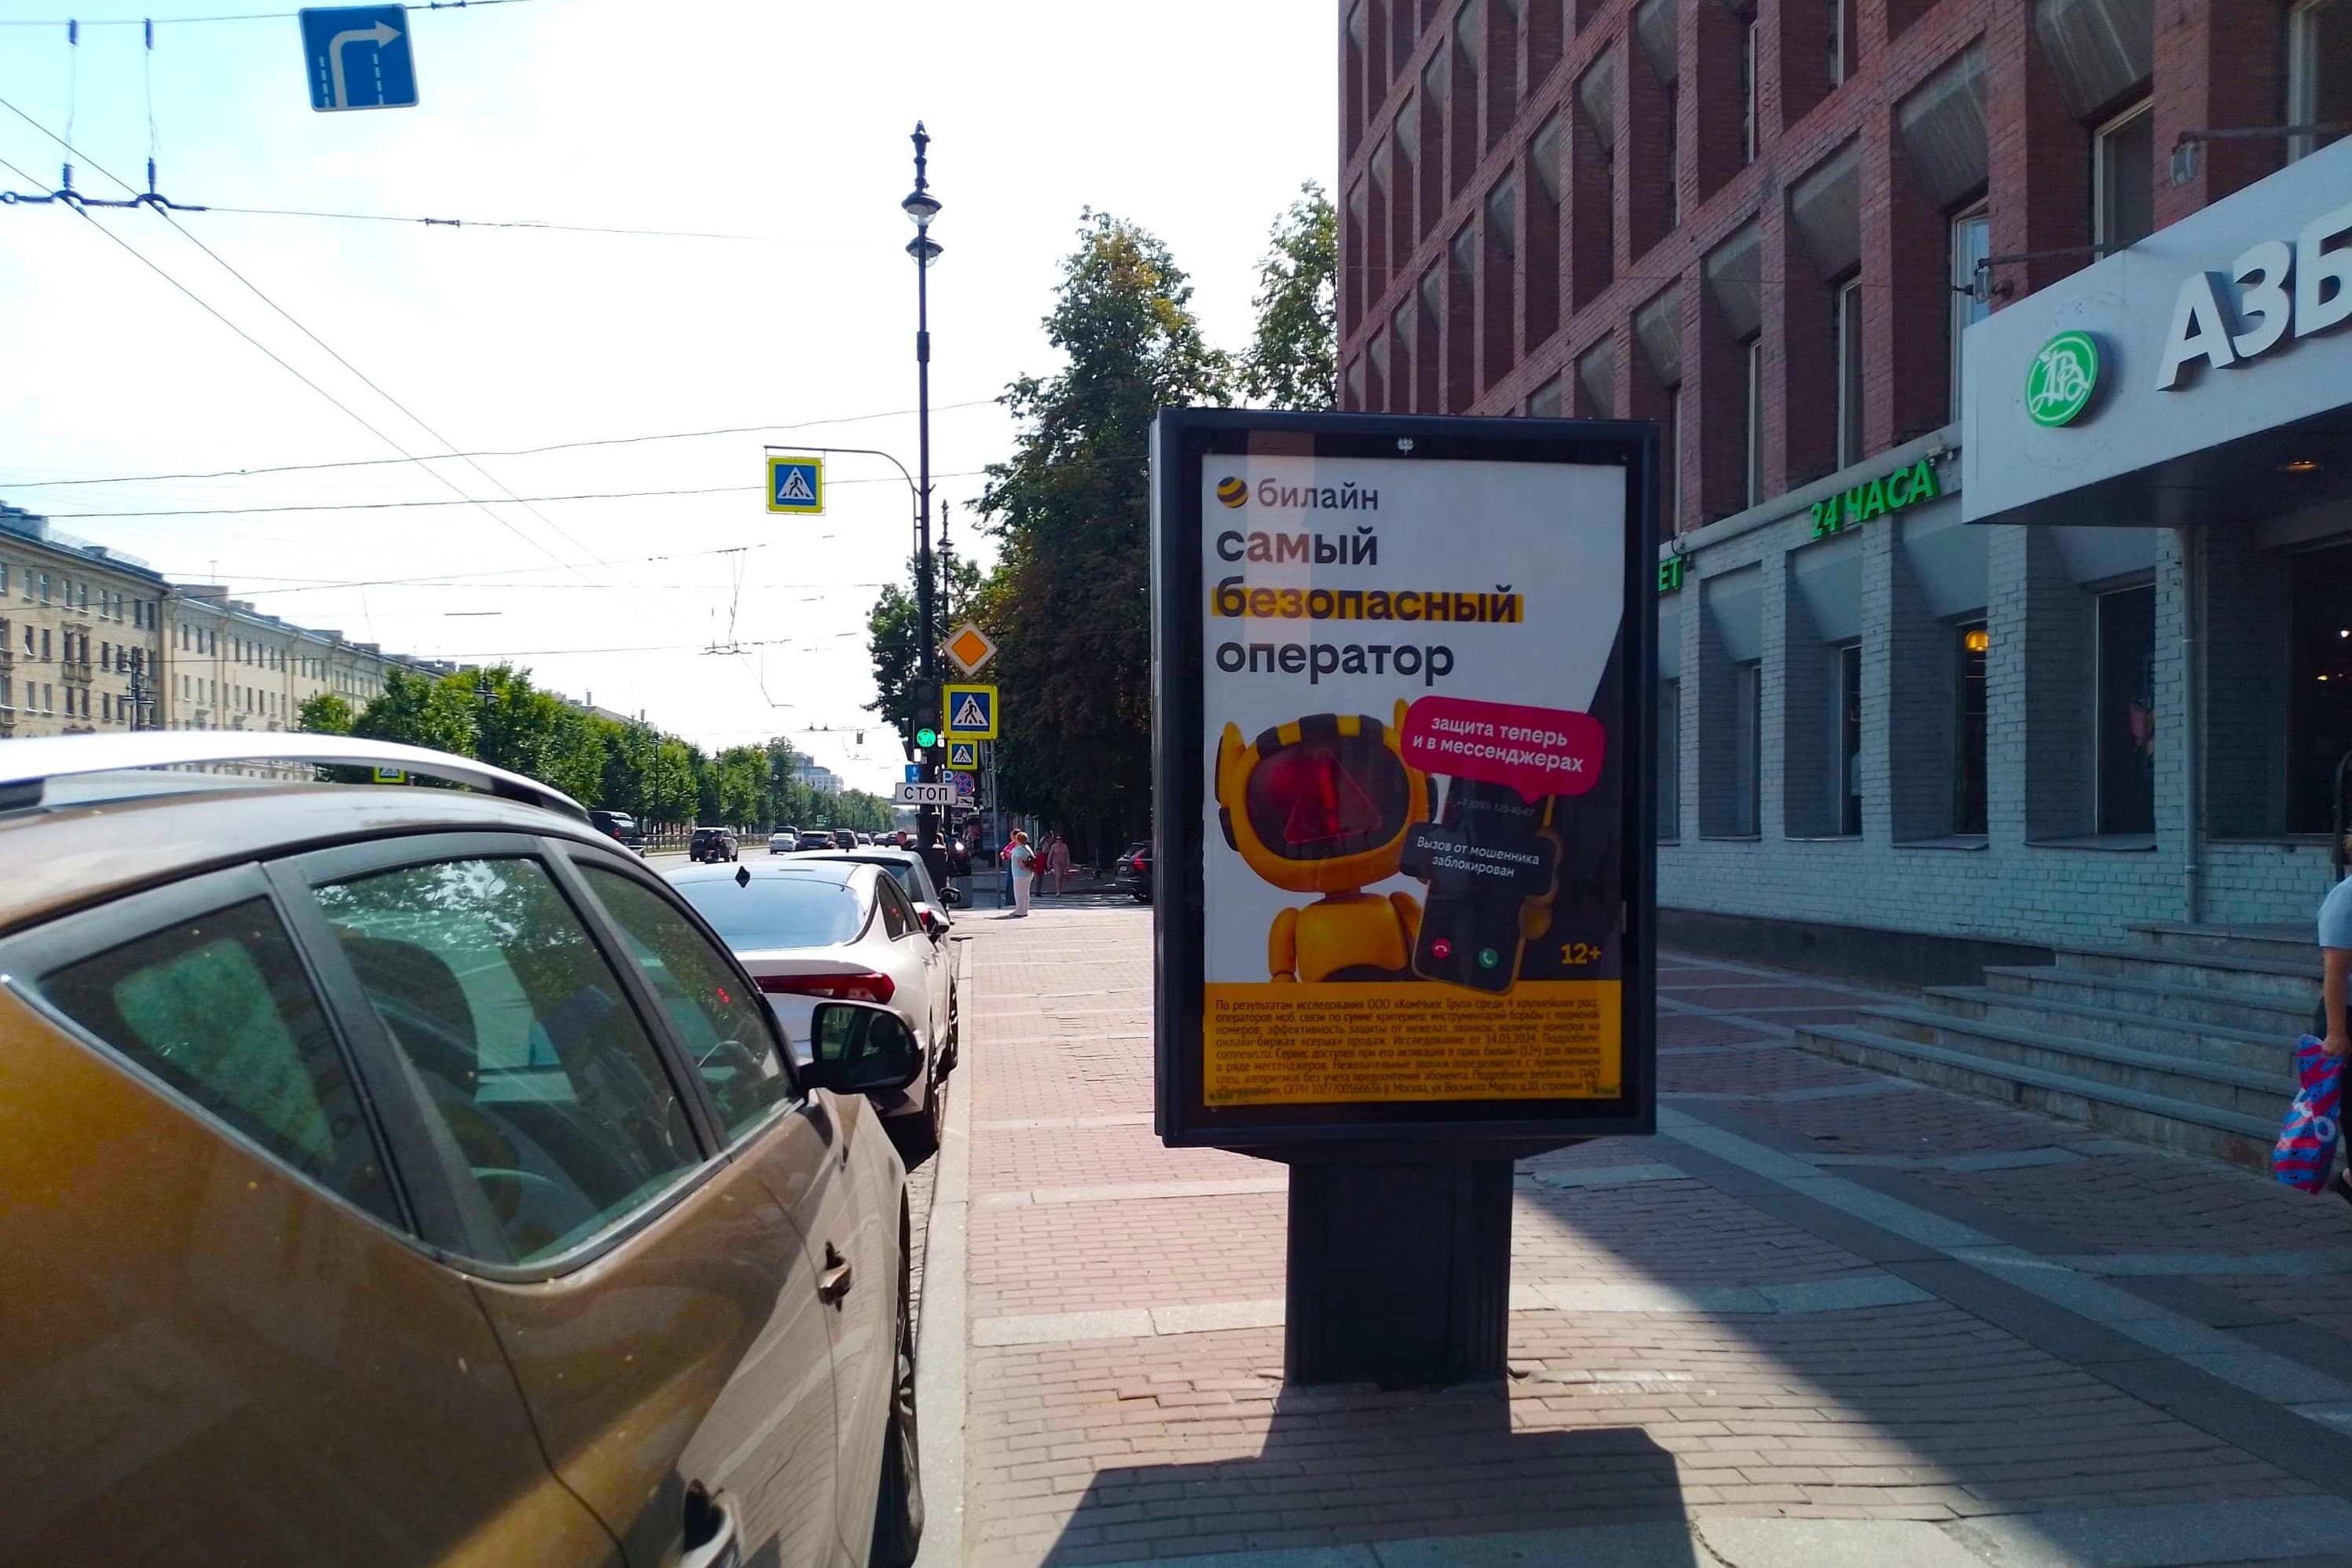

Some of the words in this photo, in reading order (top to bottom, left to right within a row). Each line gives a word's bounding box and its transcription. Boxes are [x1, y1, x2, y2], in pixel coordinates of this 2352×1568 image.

[2156, 202, 2352, 391] АЗБ
[1258, 478, 1378, 511] билайн
[1811, 496, 1837, 539] 24
[1846, 460, 1936, 523] ЧАСА
[1217, 526, 1378, 566] самый
[1217, 576, 1516, 623] безопасный
[1215, 641, 1454, 687] оператор
[1431, 717, 1494, 737] защита
[1500, 726, 1568, 749] теперь
[1413, 735, 1423, 748] и
[1427, 738, 1436, 749] в
[1440, 740, 1585, 773] мессенджерах
[904, 786, 947, 800] СТОП
[1416, 836, 1451, 852] Вызов
[1454, 844, 1467, 855] от
[1470, 847, 1540, 865] мошенника
[1431, 855, 1515, 877] заблокирован
[1561, 943, 1602, 964] 12+
